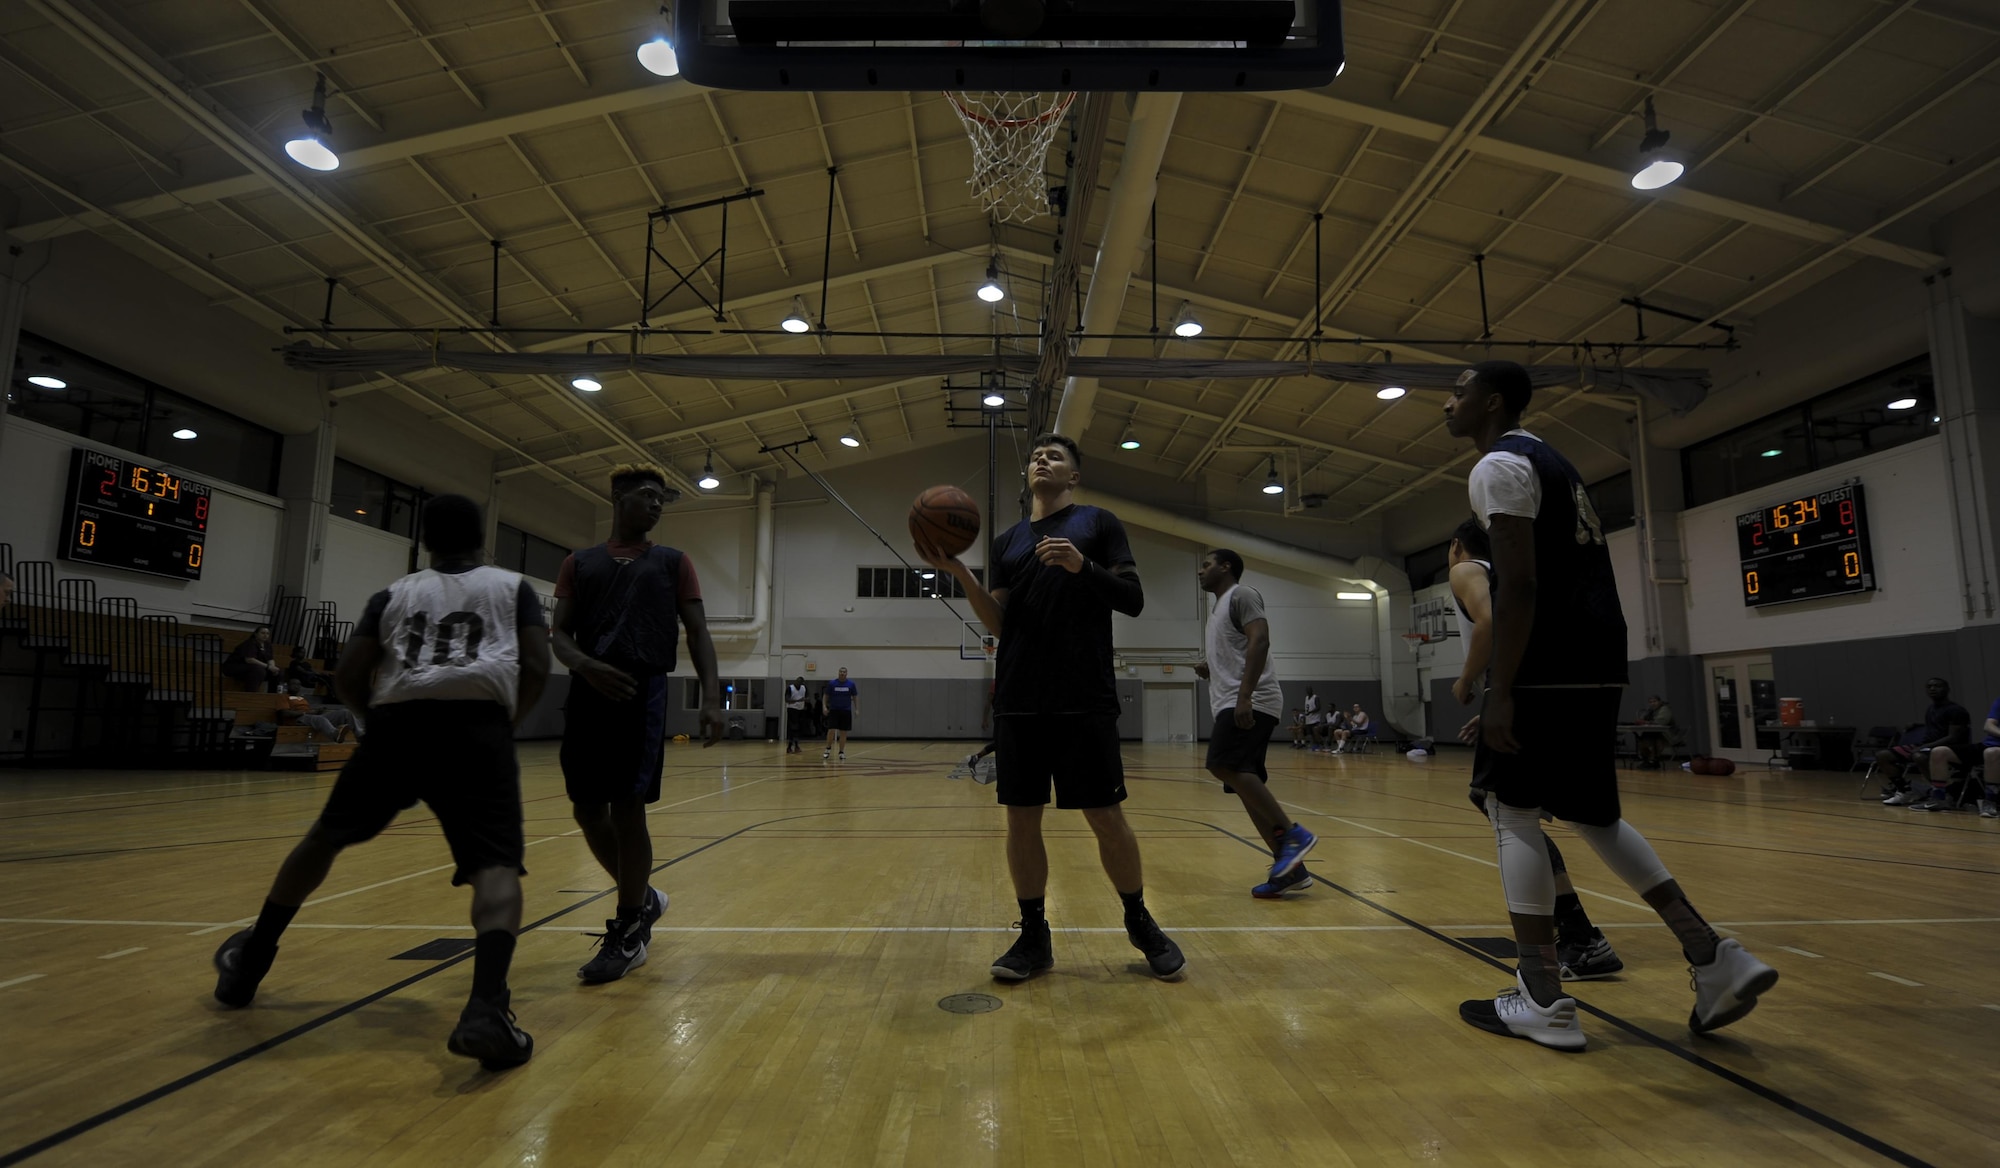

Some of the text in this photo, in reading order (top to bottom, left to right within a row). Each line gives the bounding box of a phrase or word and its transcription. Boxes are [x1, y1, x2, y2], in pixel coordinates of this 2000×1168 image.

[87, 452, 120, 471] HOME
[99, 468, 117, 497] 2
[182, 480, 211, 496] GUEST
[147, 502, 155, 516] 1
[194, 496, 210, 521] 8
[1819, 488, 1852, 505] GUEST
[1738, 511, 1762, 527] HOME
[1838, 499, 1855, 526] 8
[79, 519, 97, 547] 0
[1751, 521, 1764, 547] 2
[1792, 532, 1800, 546] 1
[188, 543, 203, 568] 0
[1843, 551, 1860, 578] 0
[1745, 571, 1760, 596] 0
[403, 611, 483, 668] 10
